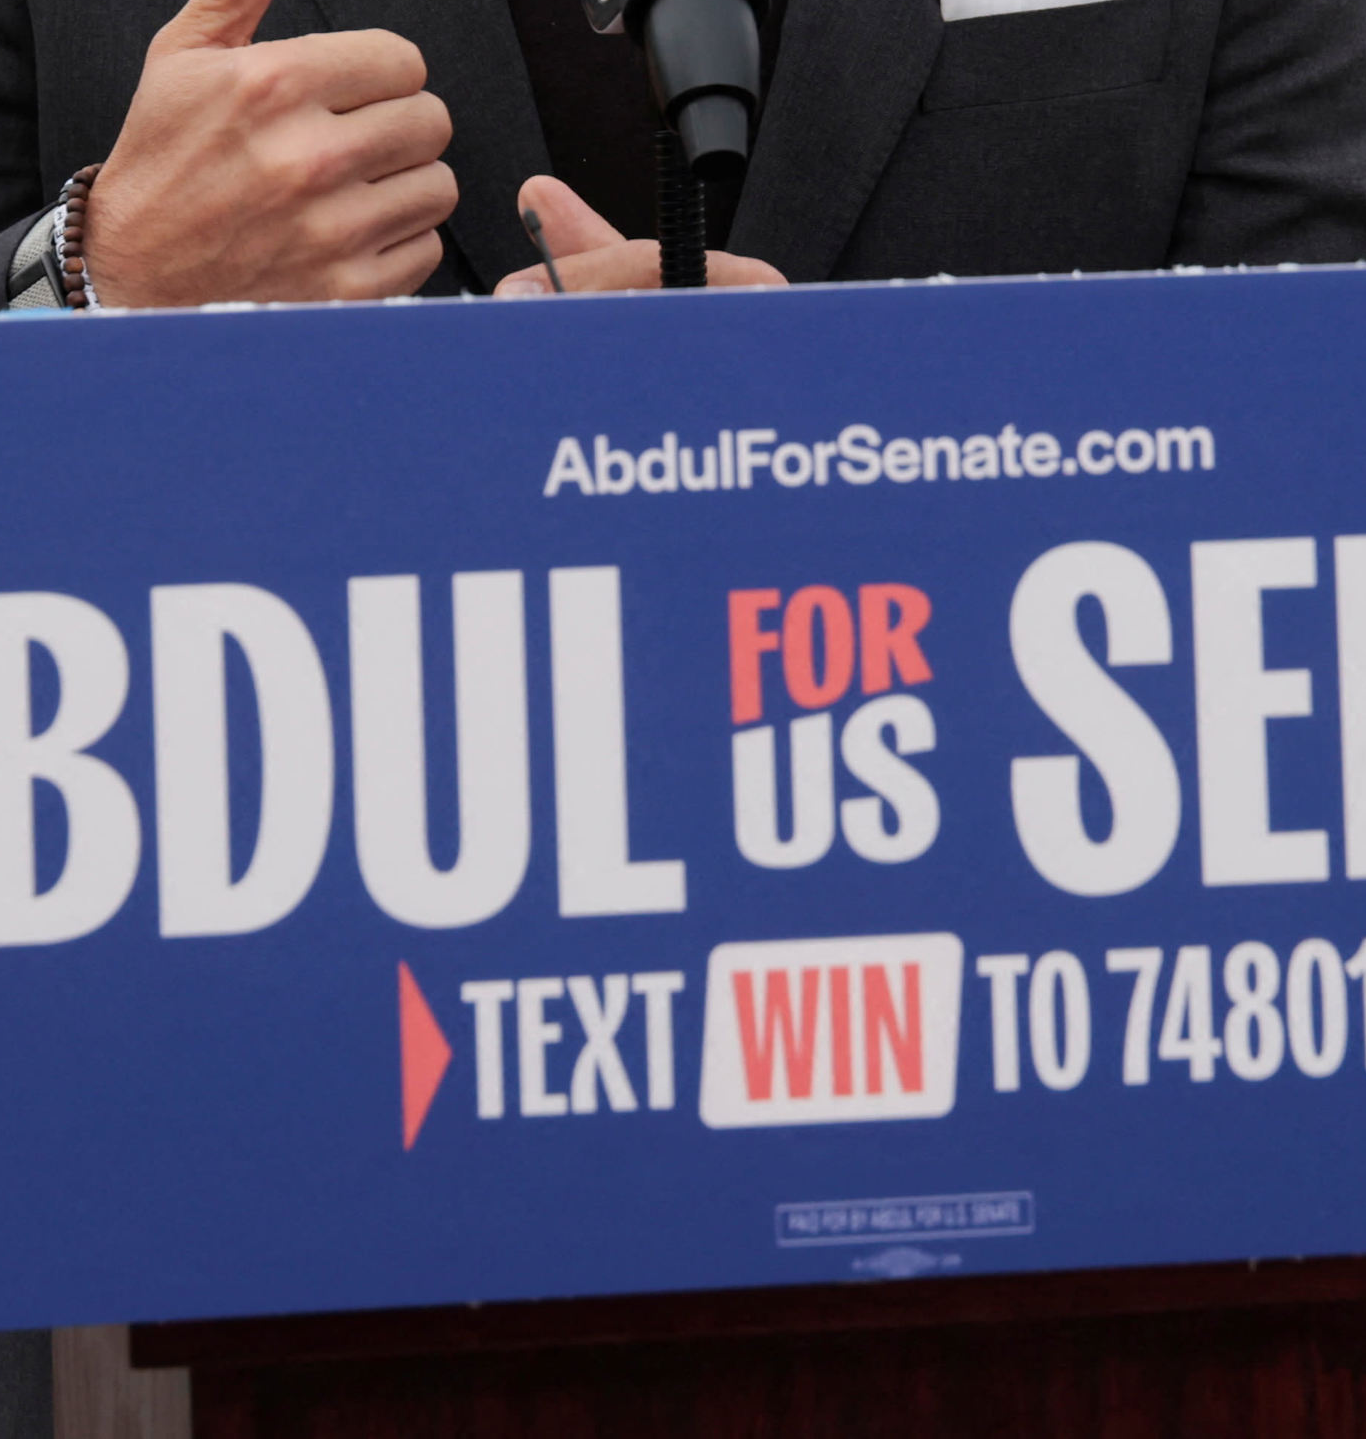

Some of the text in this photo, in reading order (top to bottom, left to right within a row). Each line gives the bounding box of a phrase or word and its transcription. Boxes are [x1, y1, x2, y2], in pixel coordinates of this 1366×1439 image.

[543, 424, 1215, 497] AbdulForSenate.com
[727, 582, 933, 725] FOR
[731, 694, 940, 869] US
[460, 971, 685, 1119] TEXT
[733, 964, 923, 1101] WIN
[976, 950, 1091, 1092] TO
